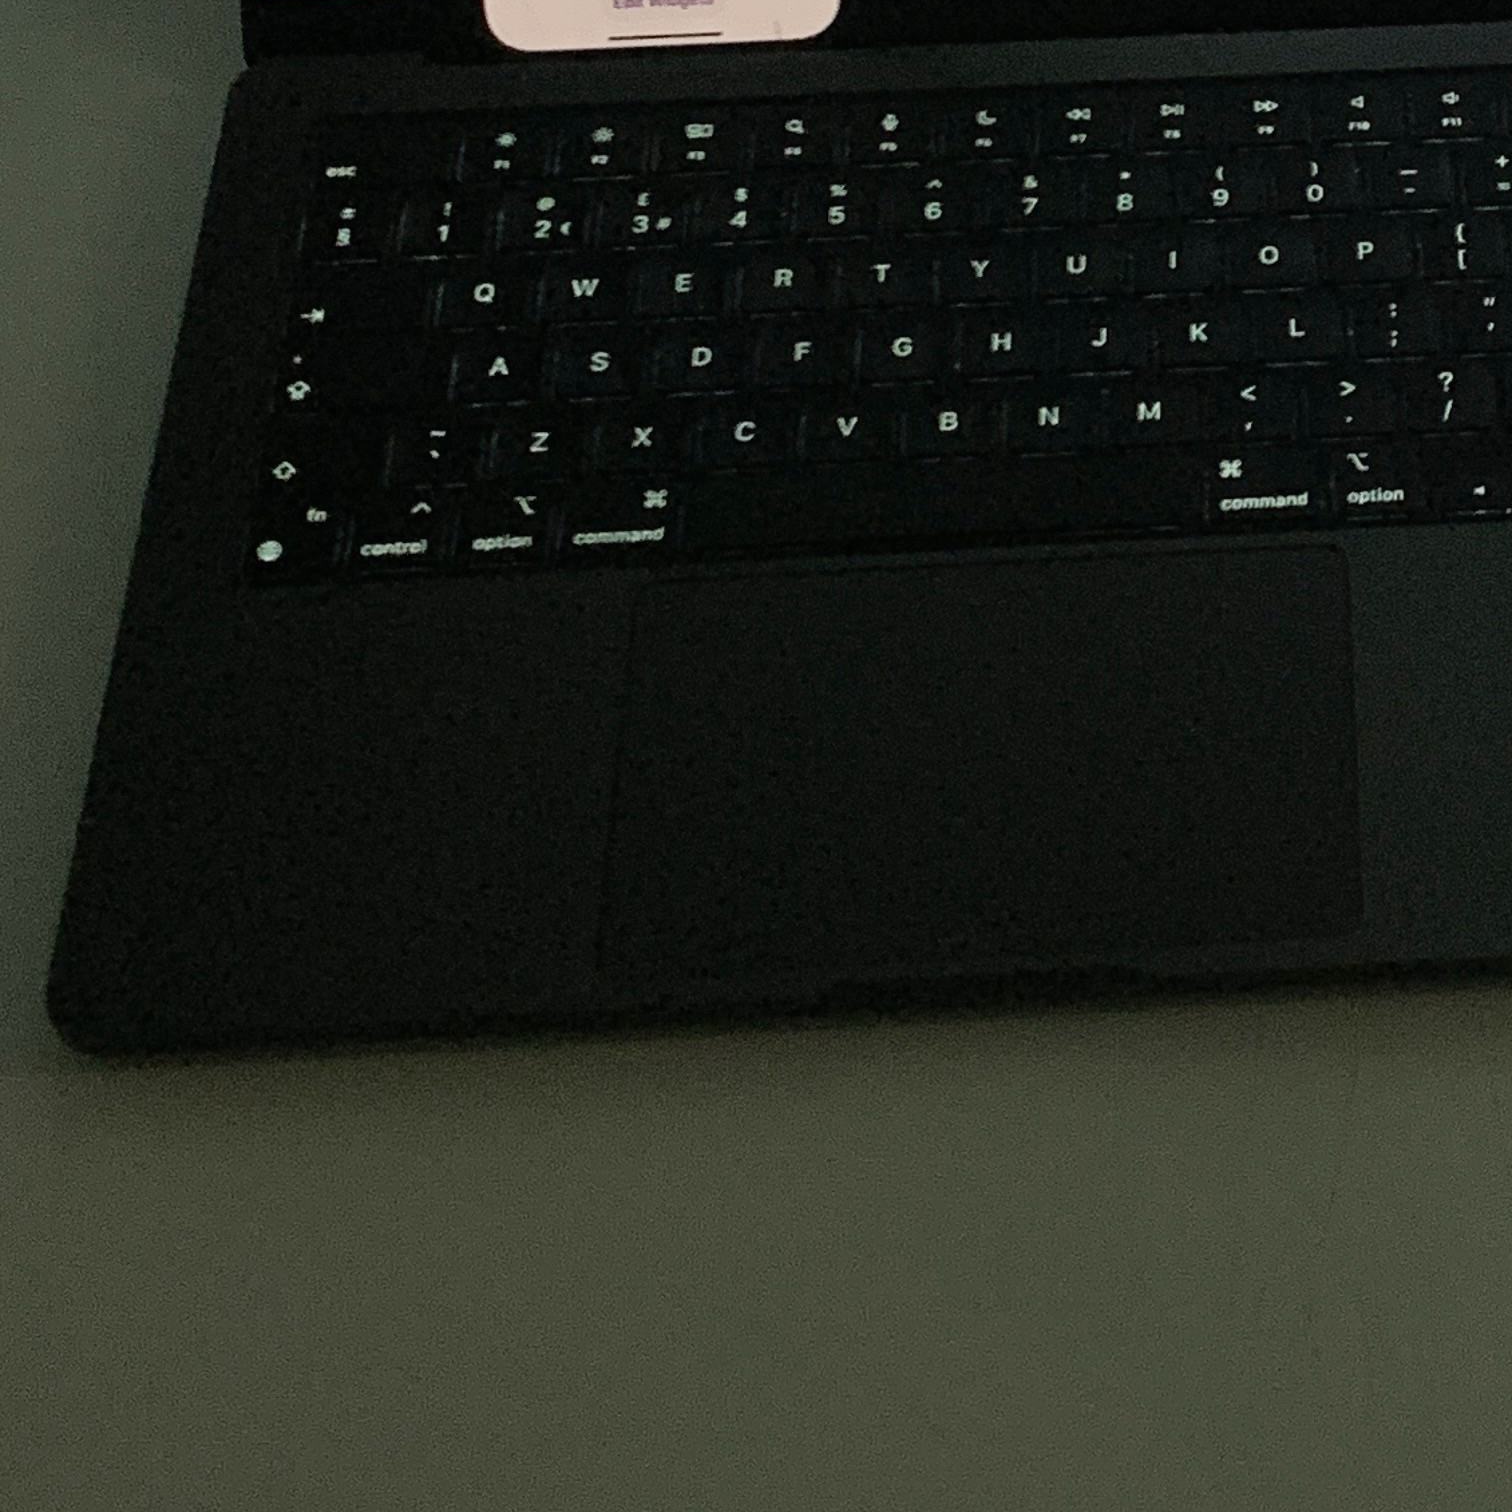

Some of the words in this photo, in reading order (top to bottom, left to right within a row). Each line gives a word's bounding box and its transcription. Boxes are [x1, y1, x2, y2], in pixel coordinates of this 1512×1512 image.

[325, 165, 357, 178] esc
[1116, 192, 1134, 212] 8
[1211, 188, 1230, 207] 9
[1306, 183, 1324, 202] 0
[828, 205, 846, 225] 5
[924, 201, 943, 220] 6
[1022, 197, 1039, 215] 7
[534, 219, 552, 239] 2
[632, 214, 650, 234] 3
[729, 210, 747, 228] 4
[438, 224, 450, 242] 1
[1169, 250, 1177, 270] I
[1258, 245, 1279, 265] O
[1357, 241, 1374, 260] P
[873, 263, 891, 283] T
[970, 260, 990, 278] Y
[1066, 254, 1087, 275] U
[571, 278, 600, 298] W
[674, 273, 693, 293] E
[773, 268, 794, 288] R
[474, 282, 495, 303] Q
[1091, 327, 1108, 347] J
[1189, 322, 1208, 342] K
[1289, 318, 1306, 337] L
[793, 341, 812, 362] F
[891, 336, 913, 357] G
[991, 332, 1012, 352] H
[590, 351, 610, 372] S
[691, 346, 713, 367] D
[488, 357, 509, 377] A
[1038, 406, 1060, 426] N
[1137, 401, 1161, 421] M
[734, 421, 756, 442] C
[836, 416, 858, 437] V
[939, 411, 959, 432] B
[529, 431, 550, 453] Z
[631, 426, 653, 447] X
[1219, 491, 1309, 511] command
[1346, 487, 1405, 505] option
[306, 508, 327, 522] fn
[472, 534, 533, 552] option
[572, 526, 665, 545] command
[359, 539, 428, 557] control
